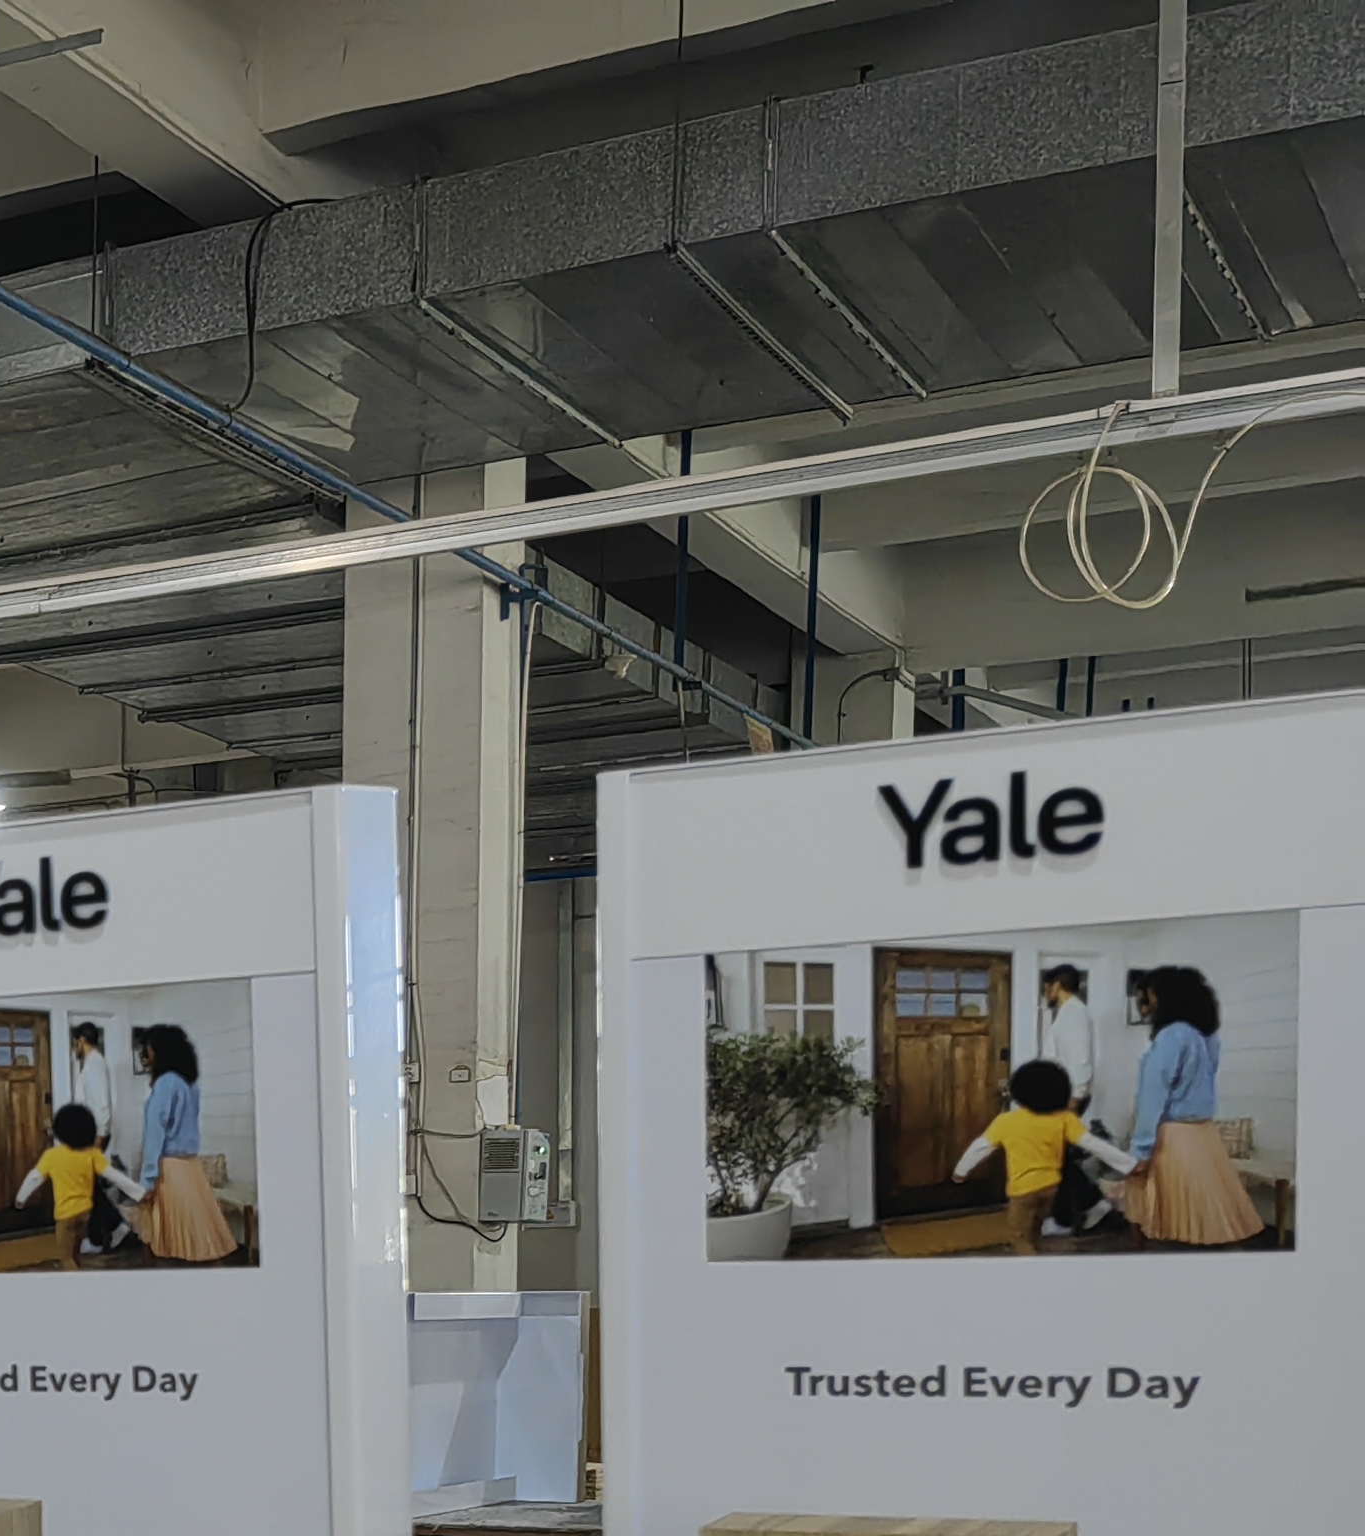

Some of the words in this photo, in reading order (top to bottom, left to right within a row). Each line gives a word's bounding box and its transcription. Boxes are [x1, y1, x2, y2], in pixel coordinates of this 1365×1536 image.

[878, 771, 1104, 869] Yale
[29, 1365, 122, 1402] Every
[132, 1365, 198, 1402] Day
[784, 1364, 947, 1398] Trusted
[963, 1366, 1092, 1409] Every
[1106, 1366, 1201, 1409] Day
